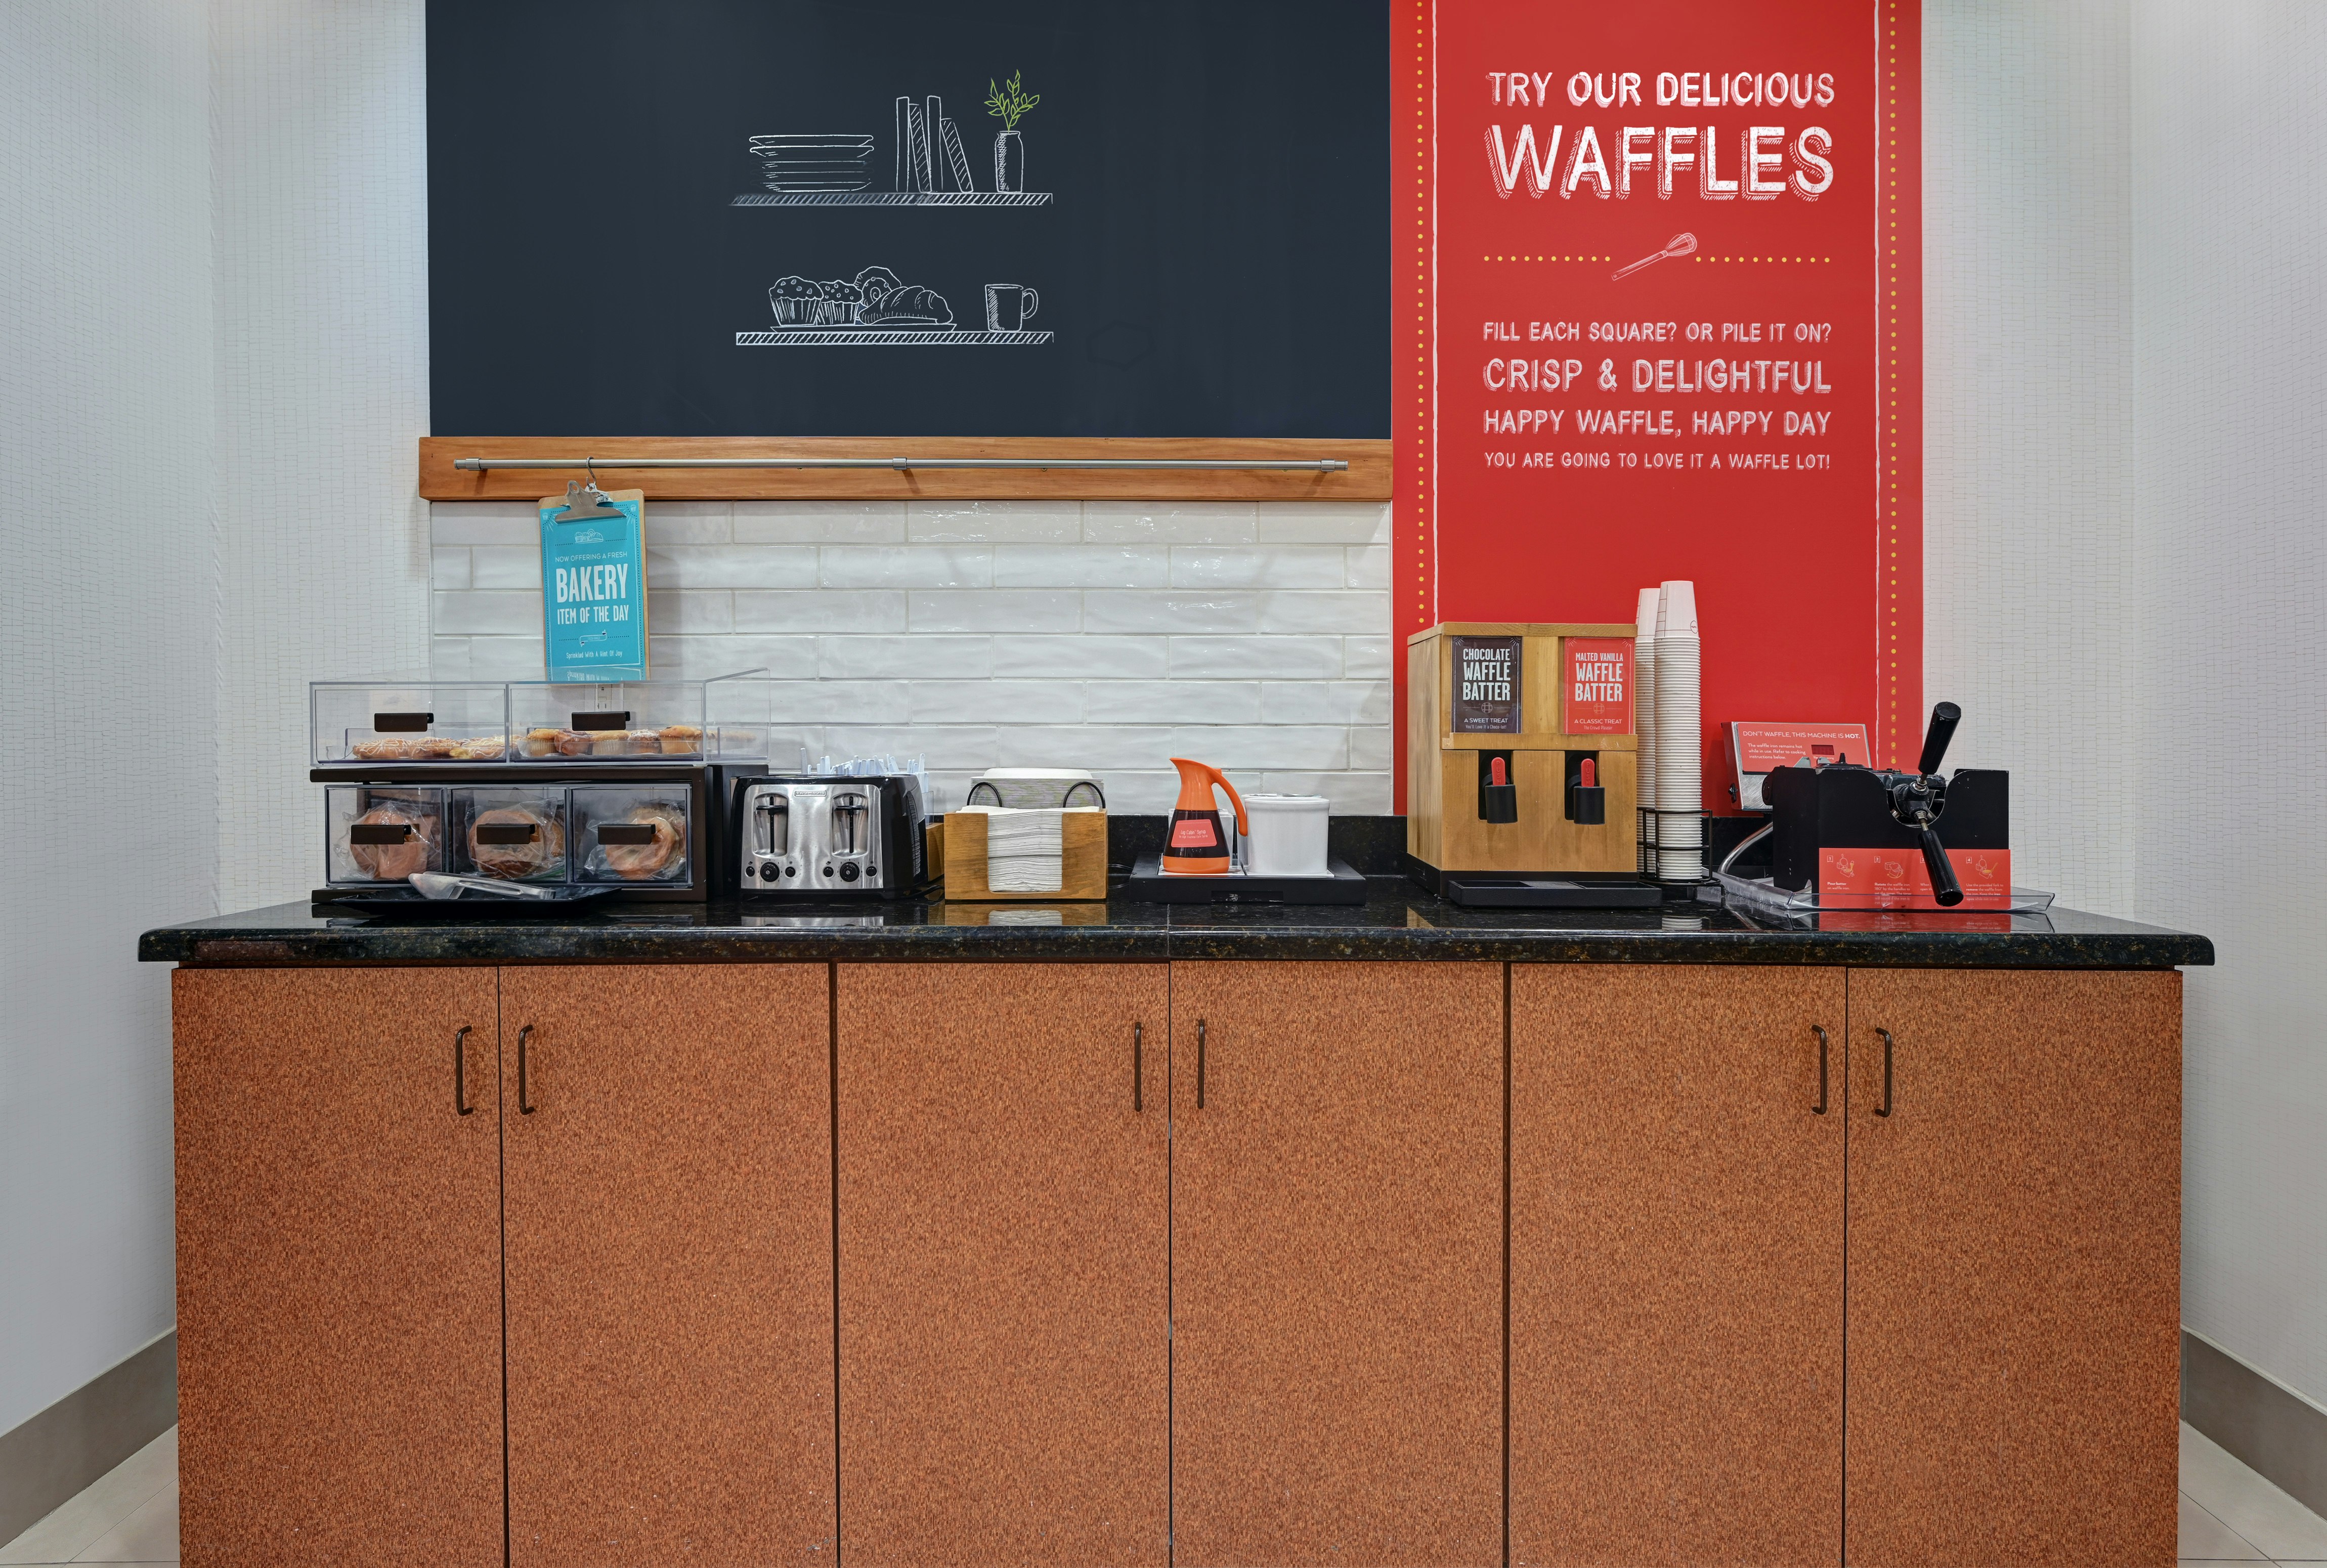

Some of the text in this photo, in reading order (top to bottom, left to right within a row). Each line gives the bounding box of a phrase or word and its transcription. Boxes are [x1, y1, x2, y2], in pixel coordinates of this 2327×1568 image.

[1486, 72, 1835, 108] TRY OUR DELICIOUS
[1484, 124, 1834, 201] WAFFLES
[1483, 322, 1832, 343] FILL EACH SQUARE? OR PILE IT ON?
[1482, 358, 1832, 395] CRISP & DELIGHTFUL
[1483, 410, 1832, 439] HAPPY WAFFLE, HAPPY DAY
[1484, 452, 1831, 470] YOU ARE GOING TO LOVE IT A WAFFLE LOT!
[571, 553, 601, 562] OFFERING
[556, 563, 628, 603] BAKERY
[557, 604, 629, 625] ITEM OF THE DAY
[1463, 648, 1511, 661] CHOCOLATE
[1576, 652, 1623, 662] MALTED VANILLA
[1463, 662, 1511, 681] WAFFLE
[1576, 663, 1623, 681] WAFFLE
[1462, 682, 1511, 701] BATTER
[1575, 683, 1623, 702] BATTER
